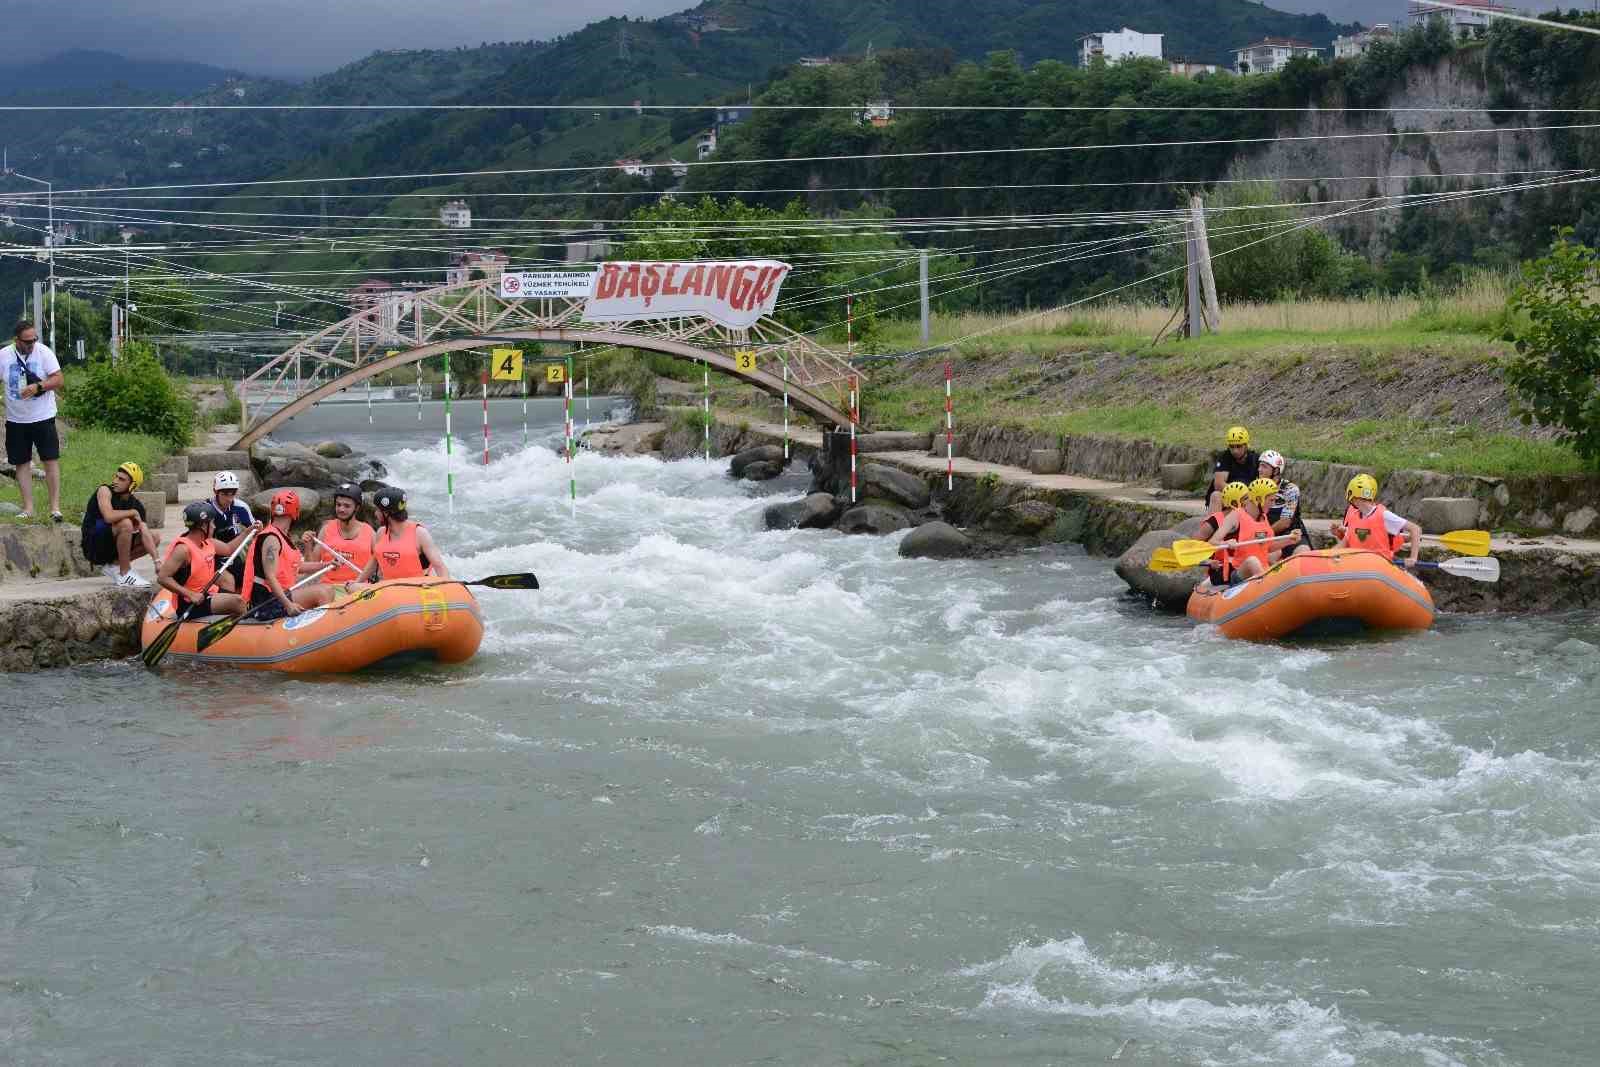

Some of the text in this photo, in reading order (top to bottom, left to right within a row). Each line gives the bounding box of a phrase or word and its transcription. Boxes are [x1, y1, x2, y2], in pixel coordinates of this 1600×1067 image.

[554, 279, 589, 287] TEHLİKELİ
[500, 354, 514, 375] 4
[741, 354, 750, 368] 3
[552, 368, 560, 379] 2
